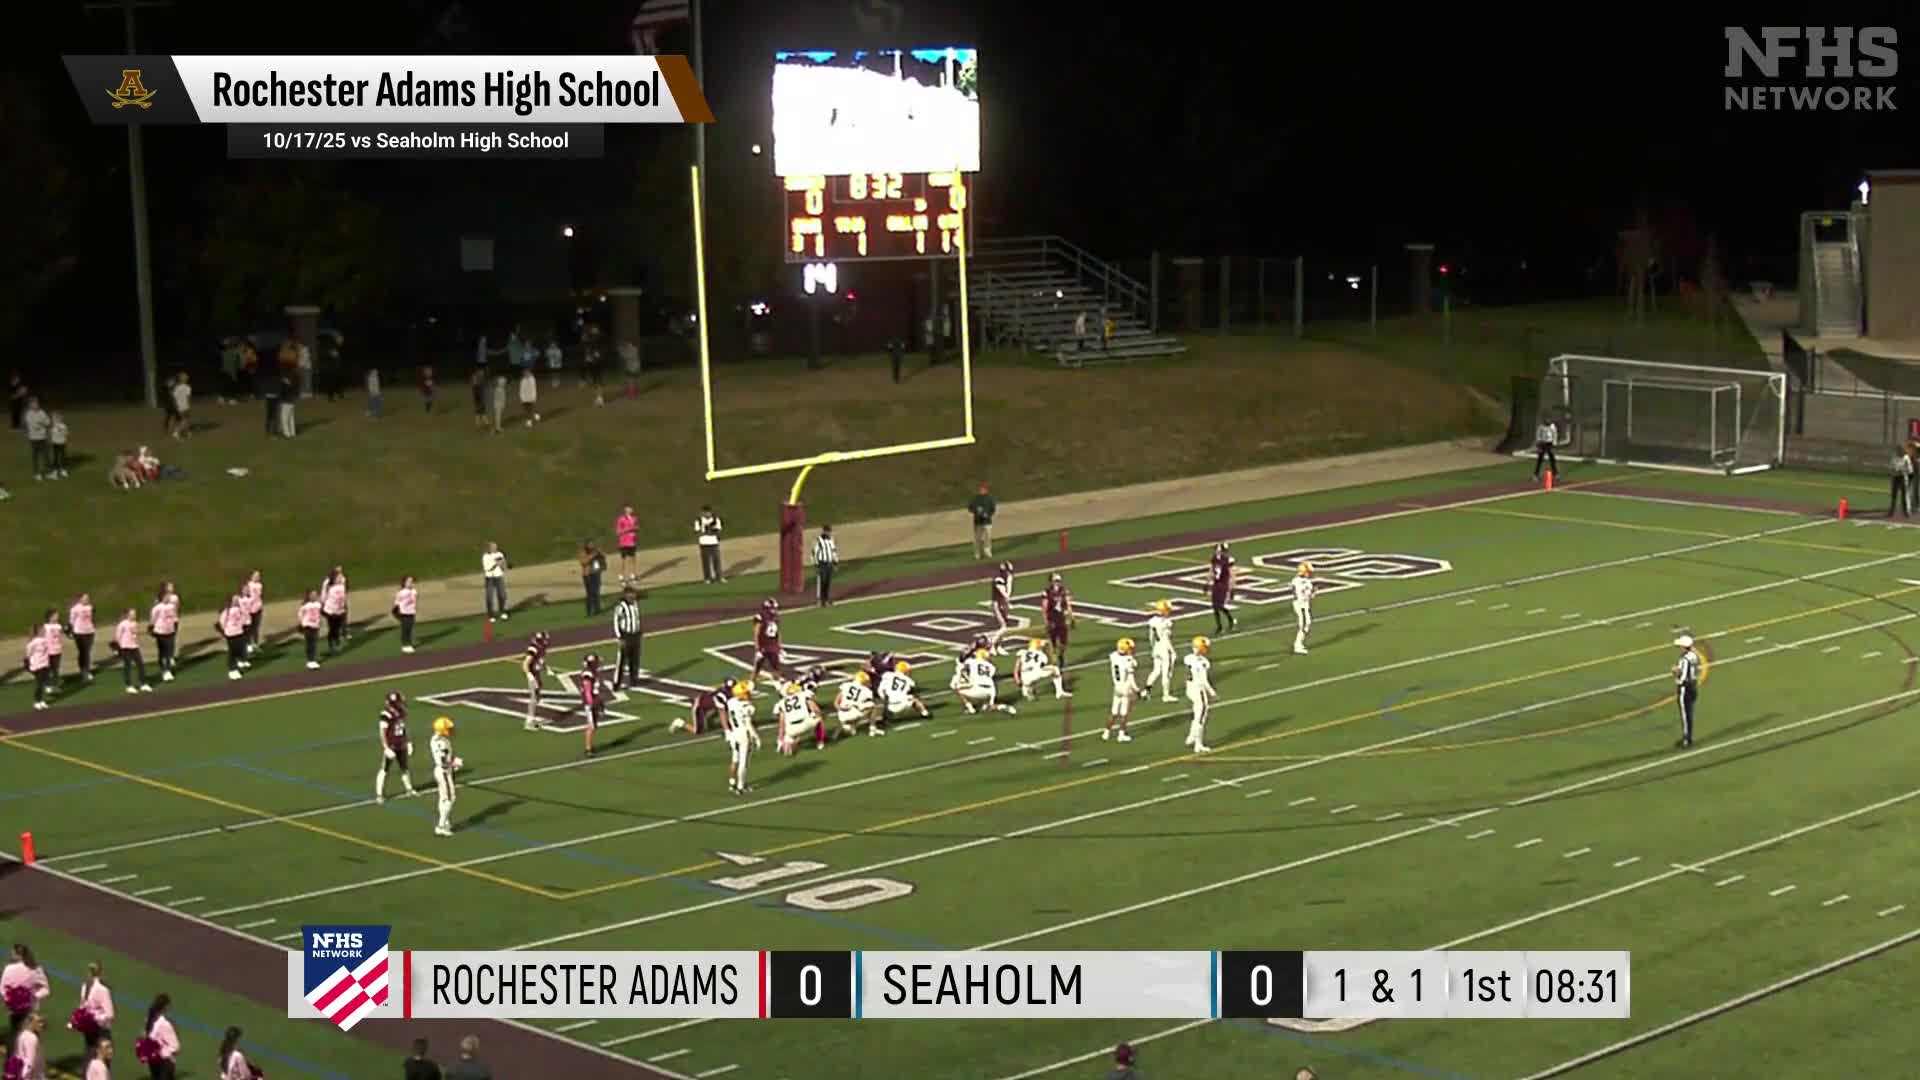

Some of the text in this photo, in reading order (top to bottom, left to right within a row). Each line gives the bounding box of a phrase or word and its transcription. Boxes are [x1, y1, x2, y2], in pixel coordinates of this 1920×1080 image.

[891, 676, 907, 693] 67
[846, 686, 862, 702] 51
[784, 696, 801, 712] 62
[708, 860, 914, 911] 10
